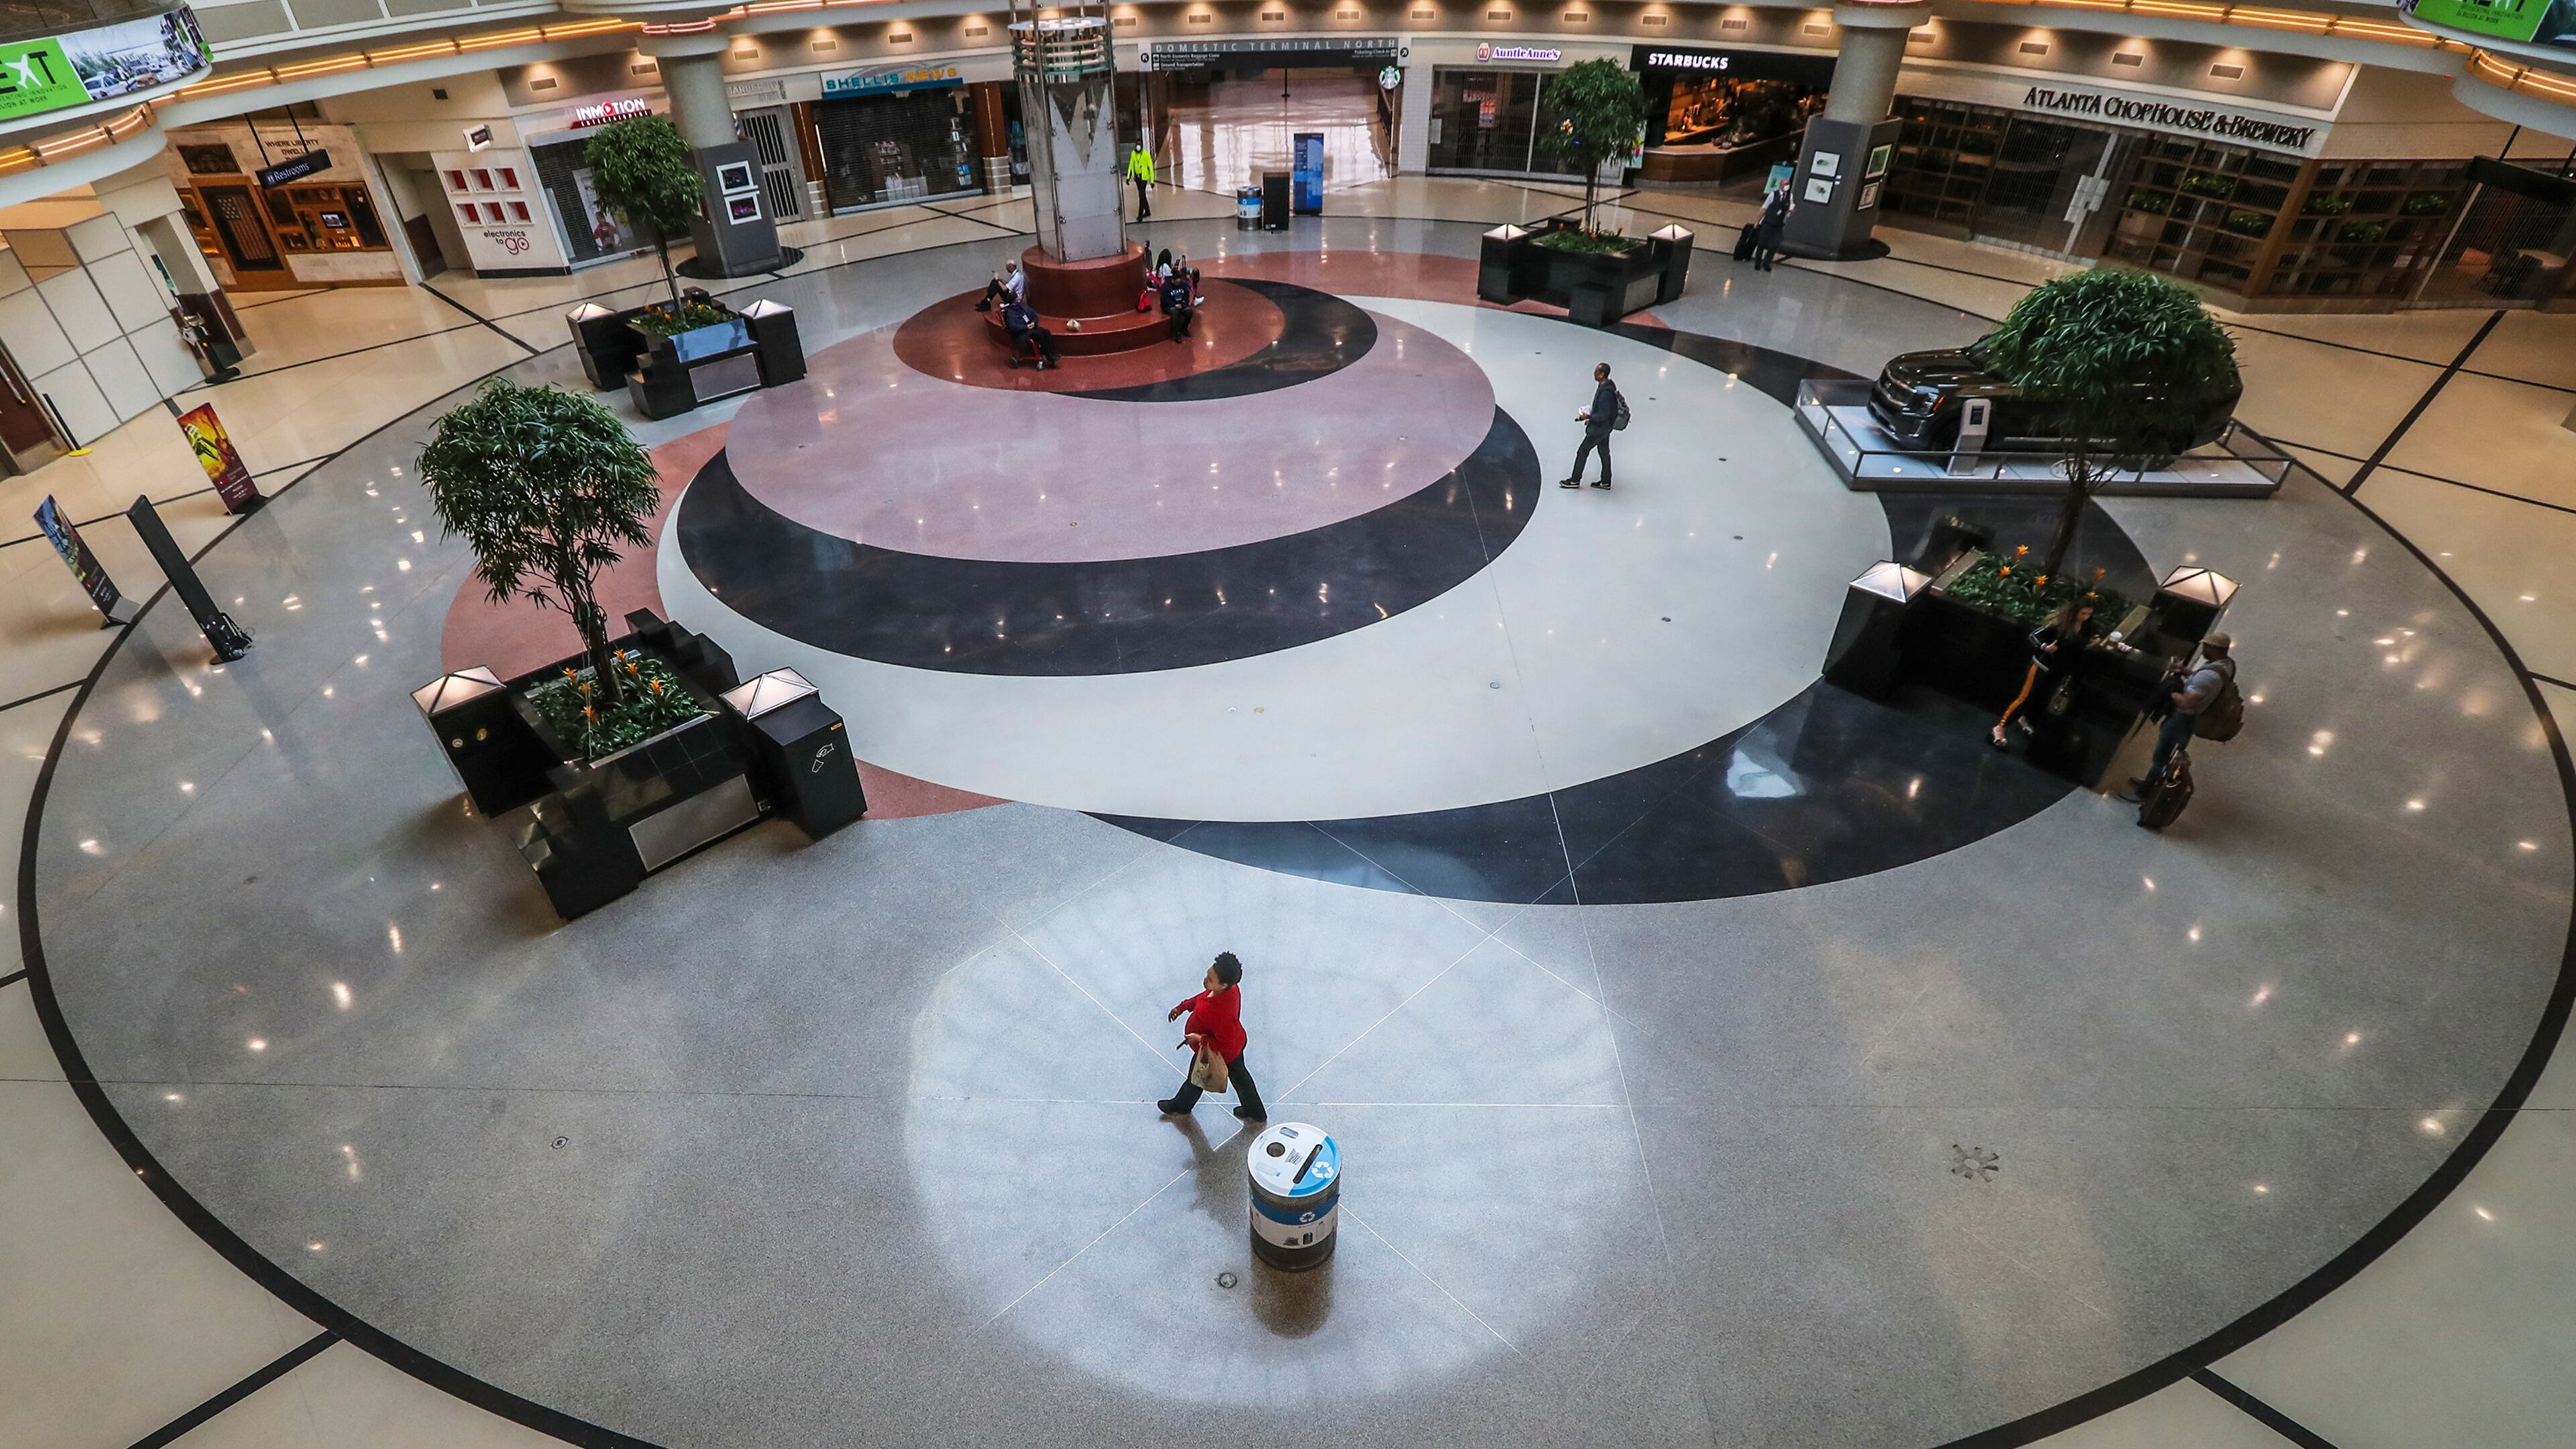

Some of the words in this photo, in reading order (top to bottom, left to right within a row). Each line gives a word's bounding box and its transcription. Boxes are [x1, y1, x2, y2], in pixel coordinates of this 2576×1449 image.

[1155, 42, 1237, 53] DOMESTIC
[1250, 41, 1331, 51] TERMINAL
[1344, 40, 1395, 50] NORTH
[1648, 53, 1729, 70] STARBUCKS
[826, 73, 900, 90] SHELLIS
[906, 68, 958, 81] NEWS
[30, 95, 48, 104] WORK
[2023, 87, 2102, 113] ATLANTA
[2228, 115, 2316, 149] BREWERY
[274, 163, 310, 182] Restrooms
[504, 237, 530, 256] go
